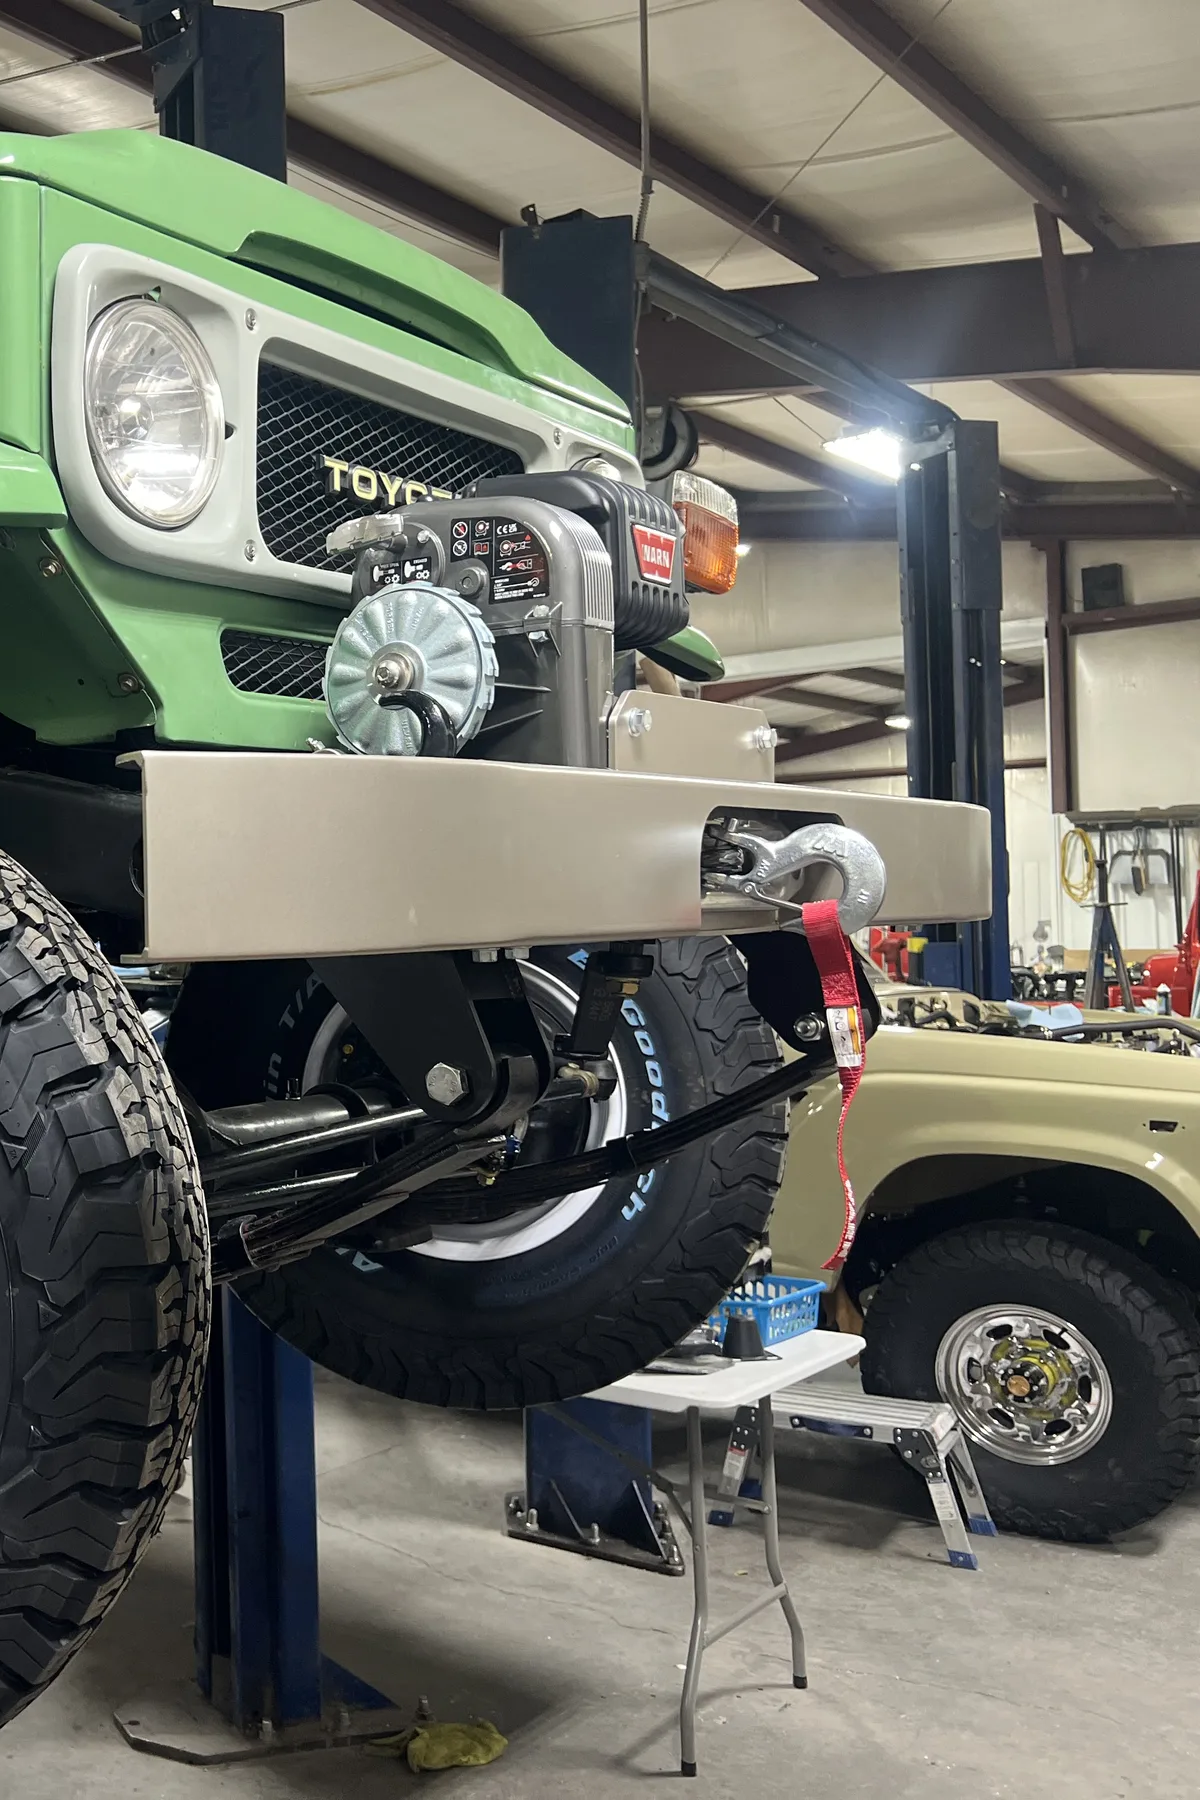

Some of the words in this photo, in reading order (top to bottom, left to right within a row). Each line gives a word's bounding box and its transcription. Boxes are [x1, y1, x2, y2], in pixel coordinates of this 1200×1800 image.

[324, 455, 455, 506] TOYO
[641, 544, 670, 568] WARN
[278, 971, 323, 1030] T/A
